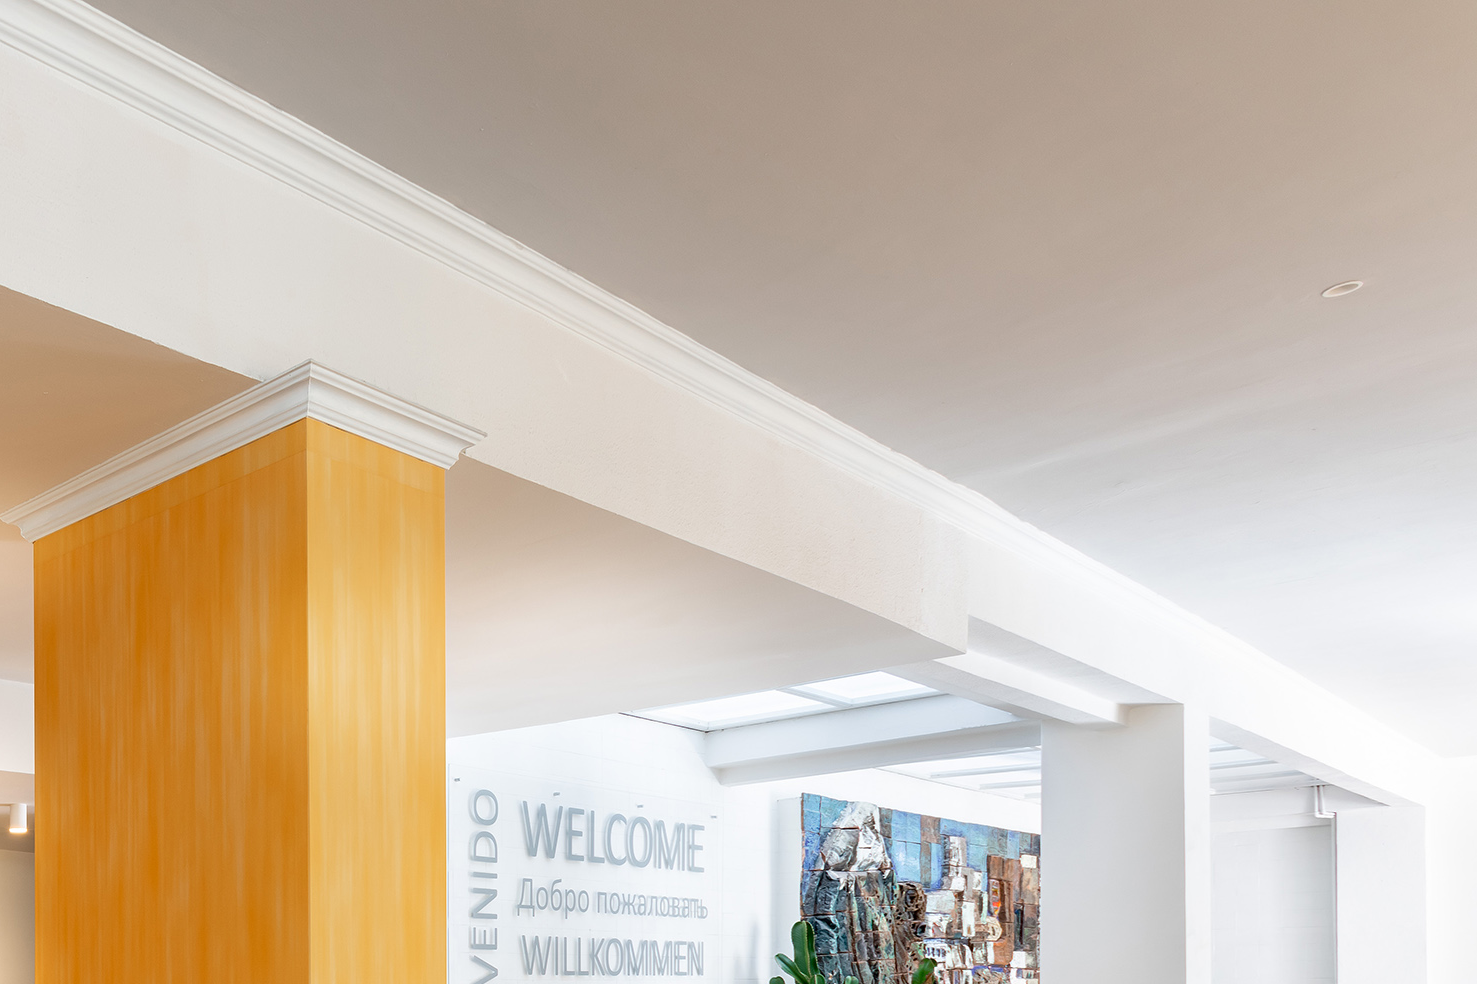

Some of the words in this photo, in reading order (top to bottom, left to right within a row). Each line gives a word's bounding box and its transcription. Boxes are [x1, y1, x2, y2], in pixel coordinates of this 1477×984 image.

[521, 800, 706, 873] WELCOME
[516, 877, 590, 919] Добро
[596, 891, 709, 919] пожаловать
[521, 934, 705, 976] WILLKOMMEN
